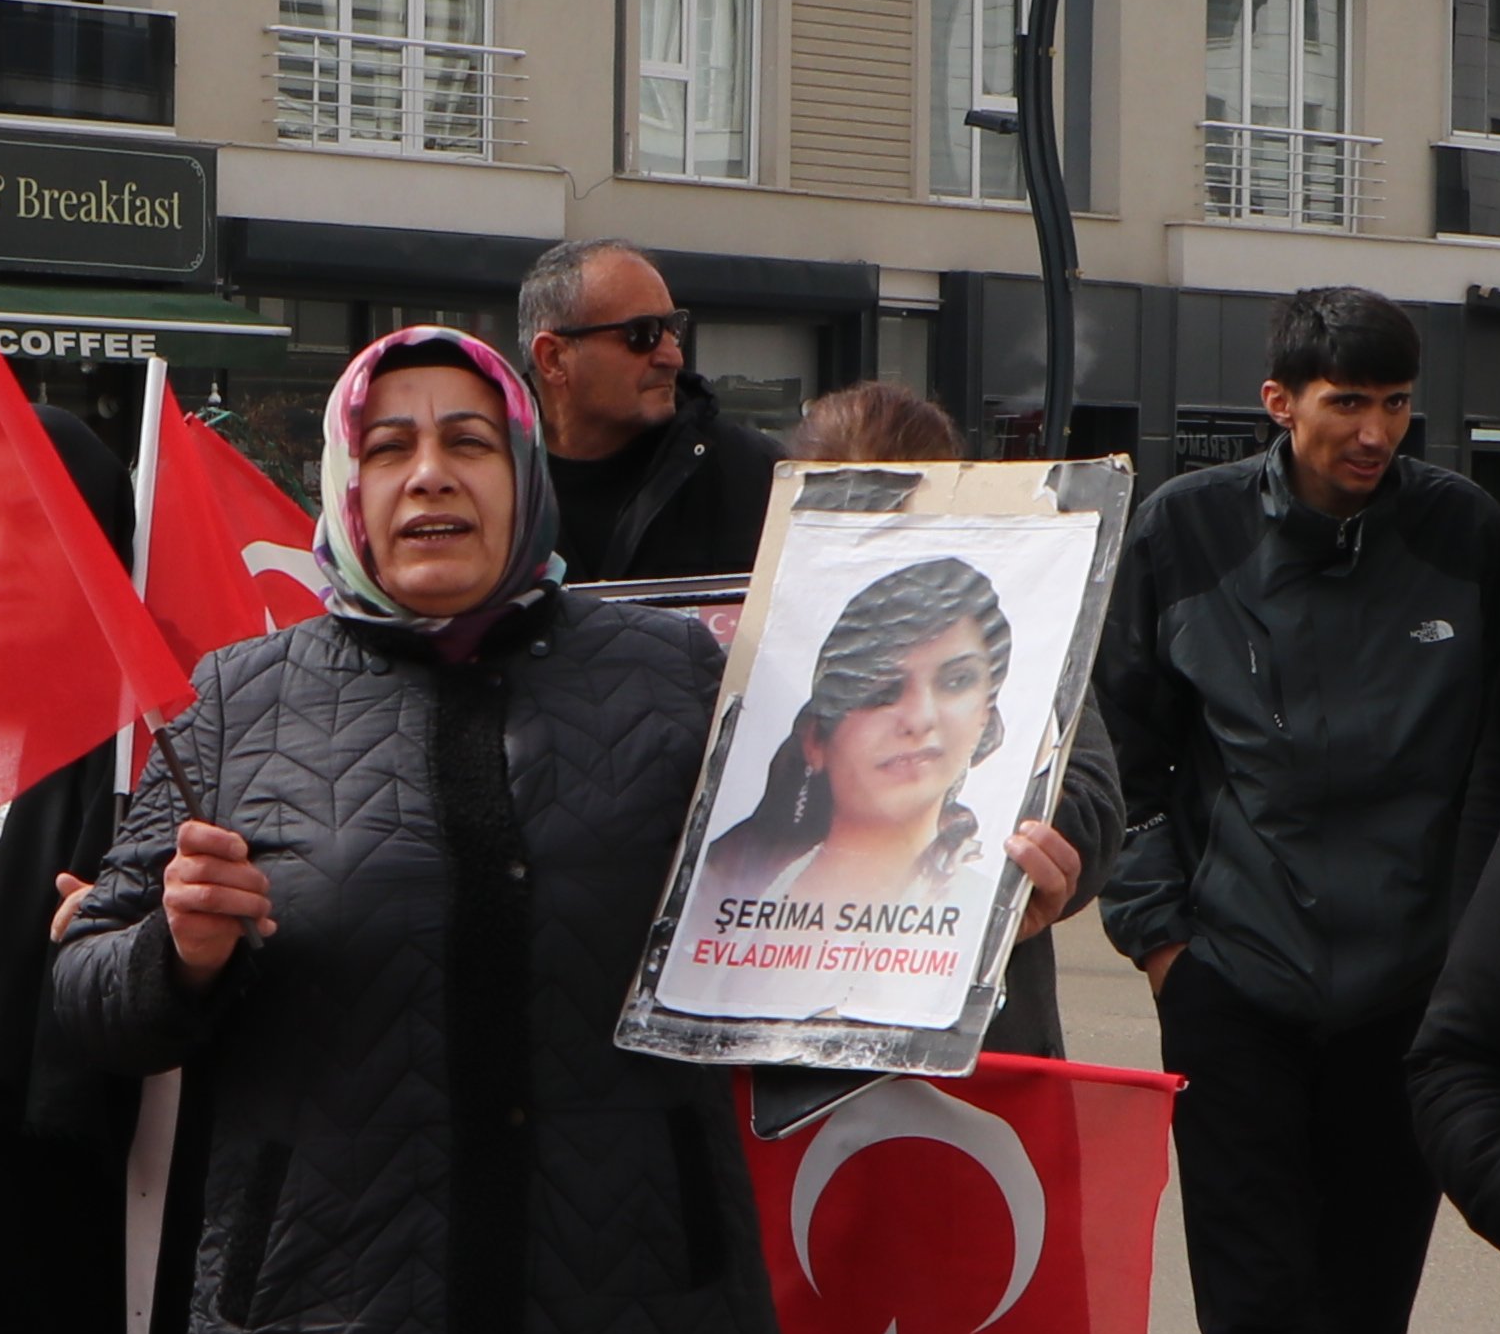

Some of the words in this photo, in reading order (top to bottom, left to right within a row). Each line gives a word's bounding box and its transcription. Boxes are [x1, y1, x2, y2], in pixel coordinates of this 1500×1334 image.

[16, 175, 183, 230] Breakfast
[714, 895, 824, 934] ŞERİMA
[834, 902, 961, 938] SANCAR
[692, 939, 810, 969] EVLADIMI
[816, 939, 960, 977] İSTİYORUM!
